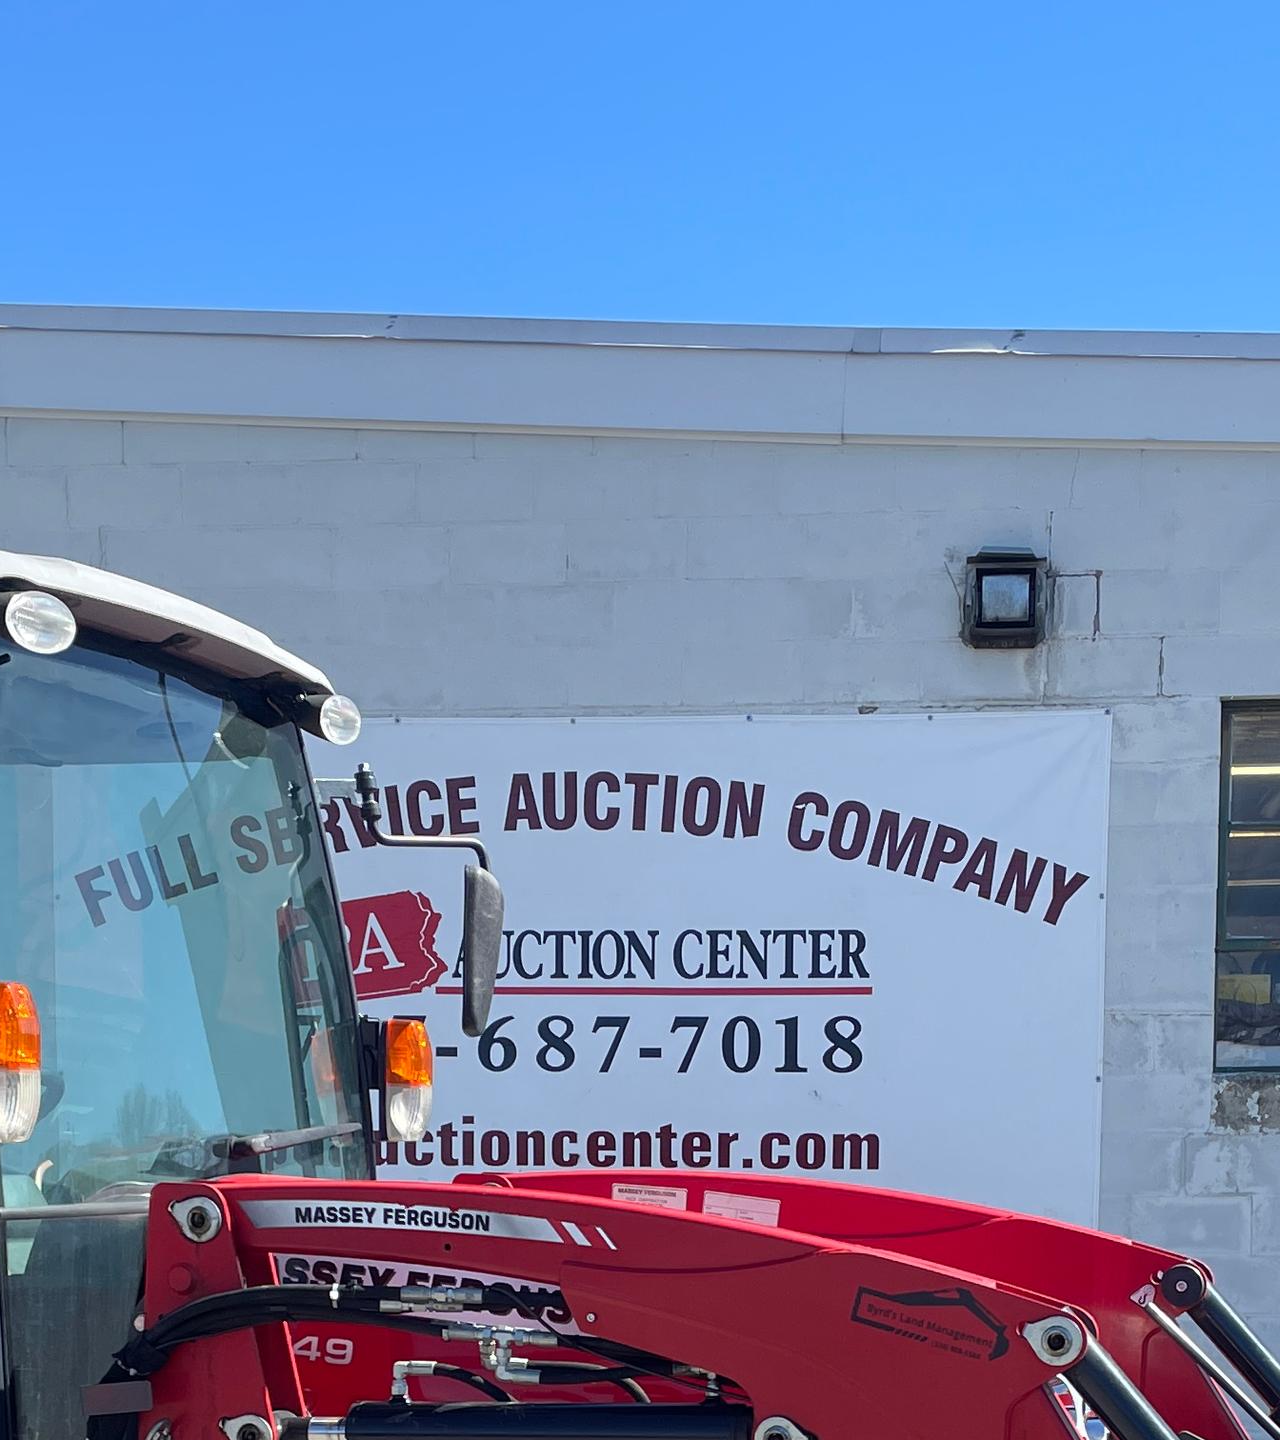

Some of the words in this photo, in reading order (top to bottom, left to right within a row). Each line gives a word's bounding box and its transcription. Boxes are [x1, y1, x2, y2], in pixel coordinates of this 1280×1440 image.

[74, 833, 218, 928] FULL
[503, 771, 765, 838] AUCTION
[787, 791, 1089, 926] COMPANY
[673, 929, 870, 980] CENTER
[295, 1206, 376, 1225] MASSEY
[383, 1208, 490, 1231] FERGUSON
[900, 1312, 924, 1327] Land
[927, 1322, 993, 1348] Management
